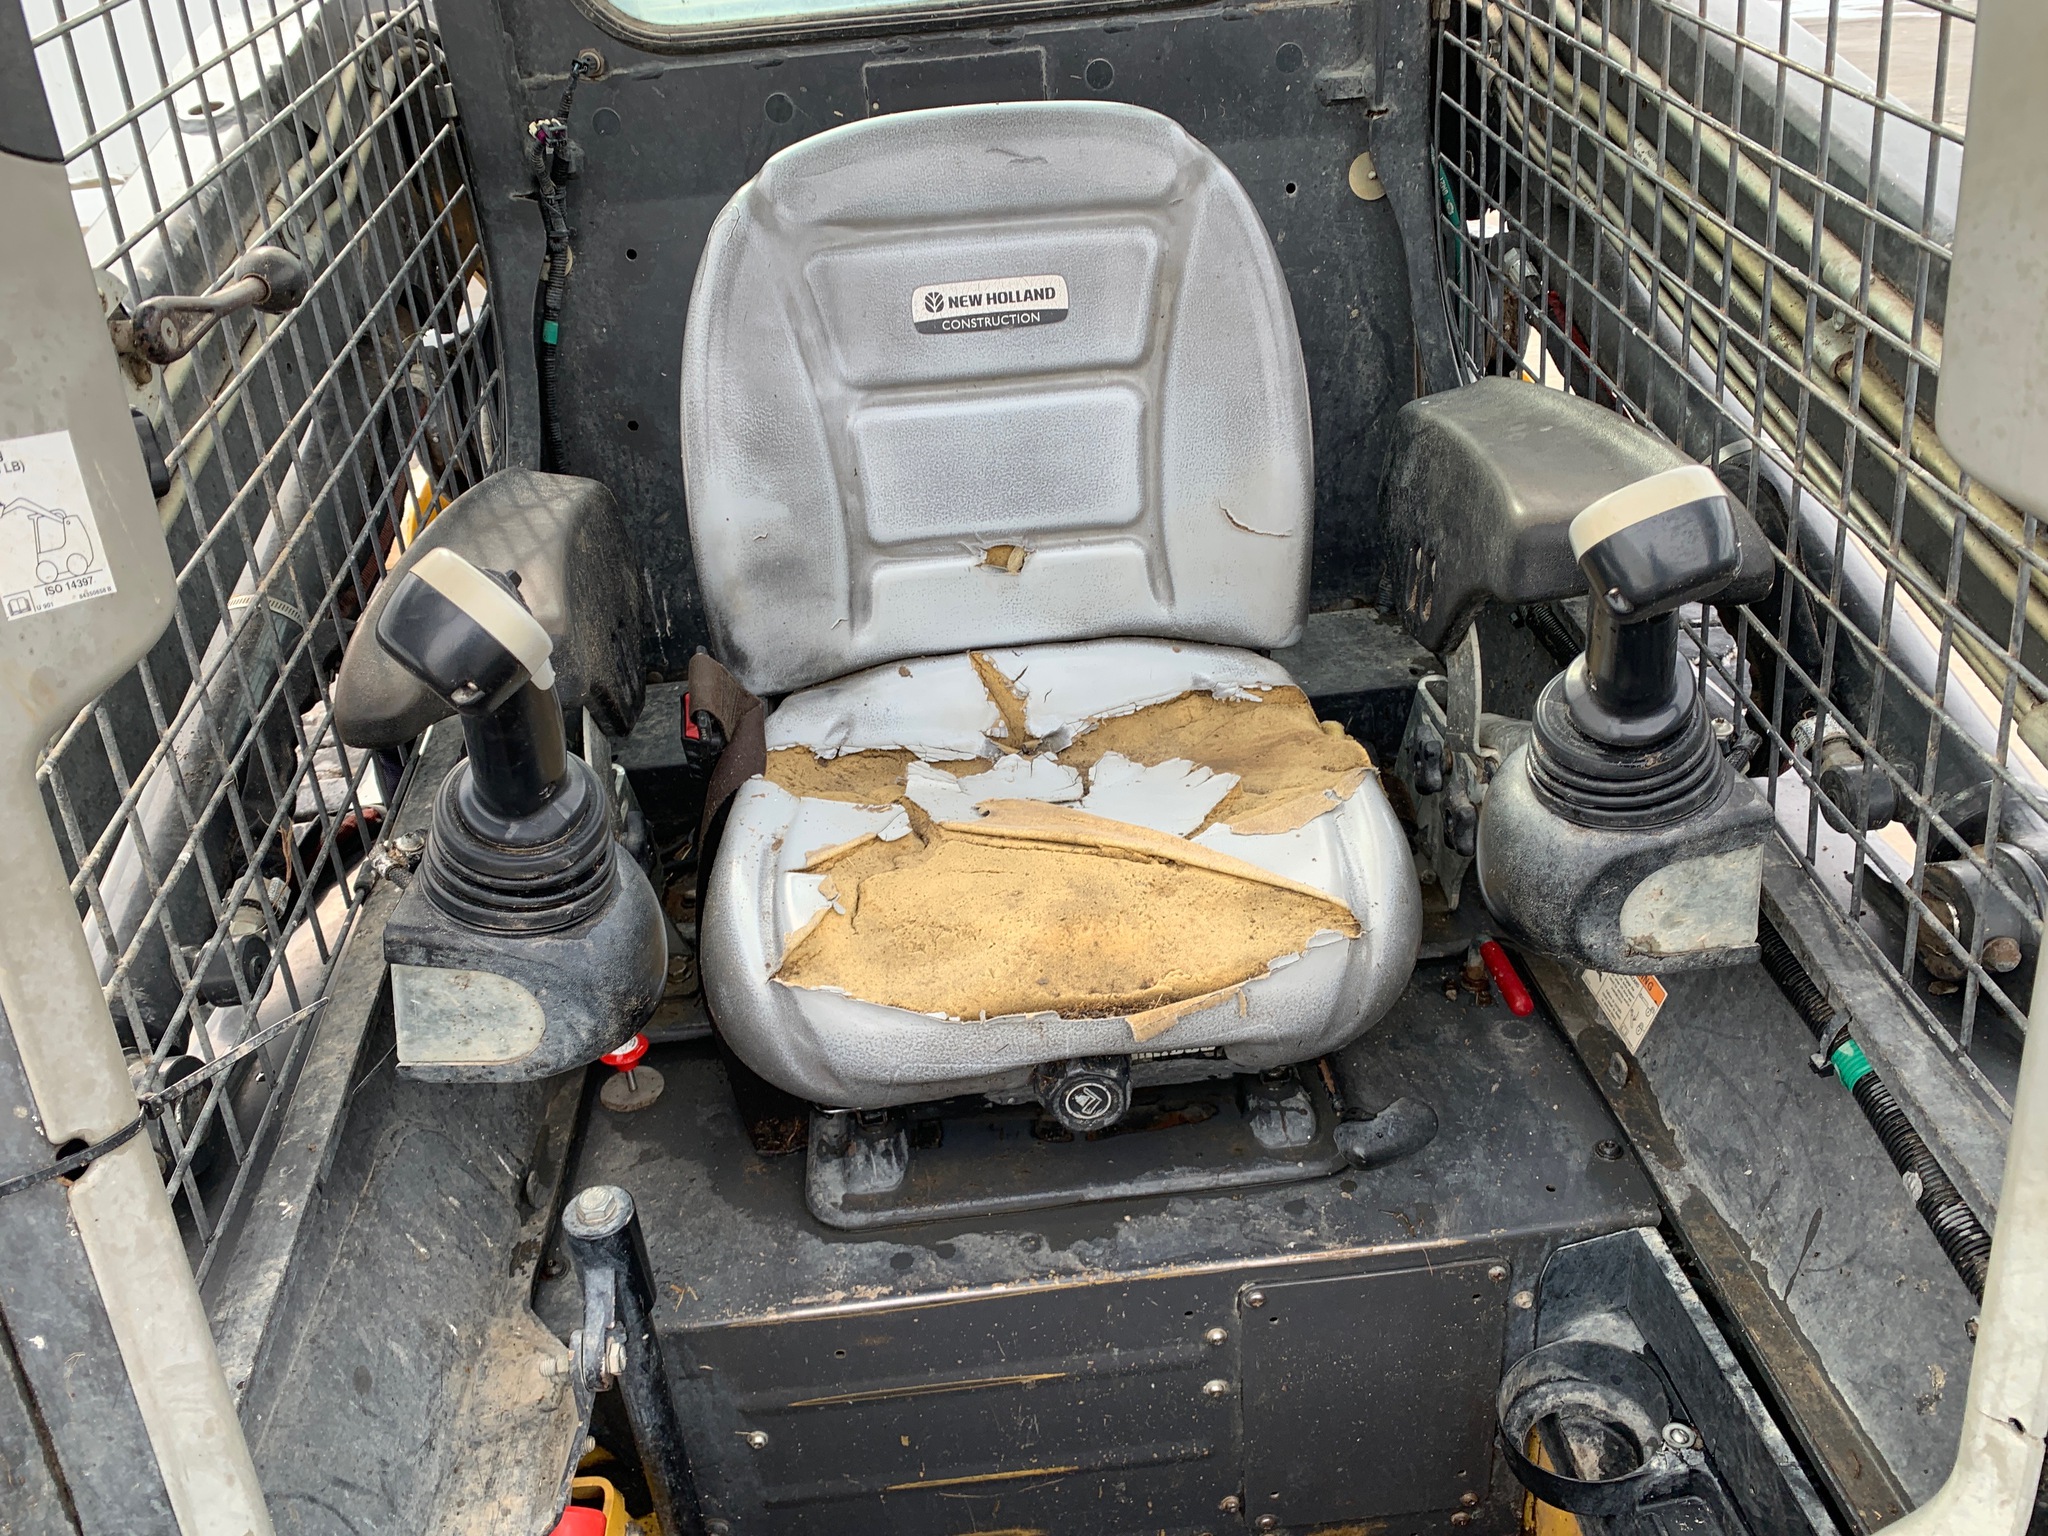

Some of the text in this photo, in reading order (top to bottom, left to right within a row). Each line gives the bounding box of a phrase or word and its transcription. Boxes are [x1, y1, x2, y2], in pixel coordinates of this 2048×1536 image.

[948, 286, 1056, 309] NEW HOLLAND
[942, 311, 1041, 331] CONSTRUCTION
[45, 576, 93, 597] ISO 14397
